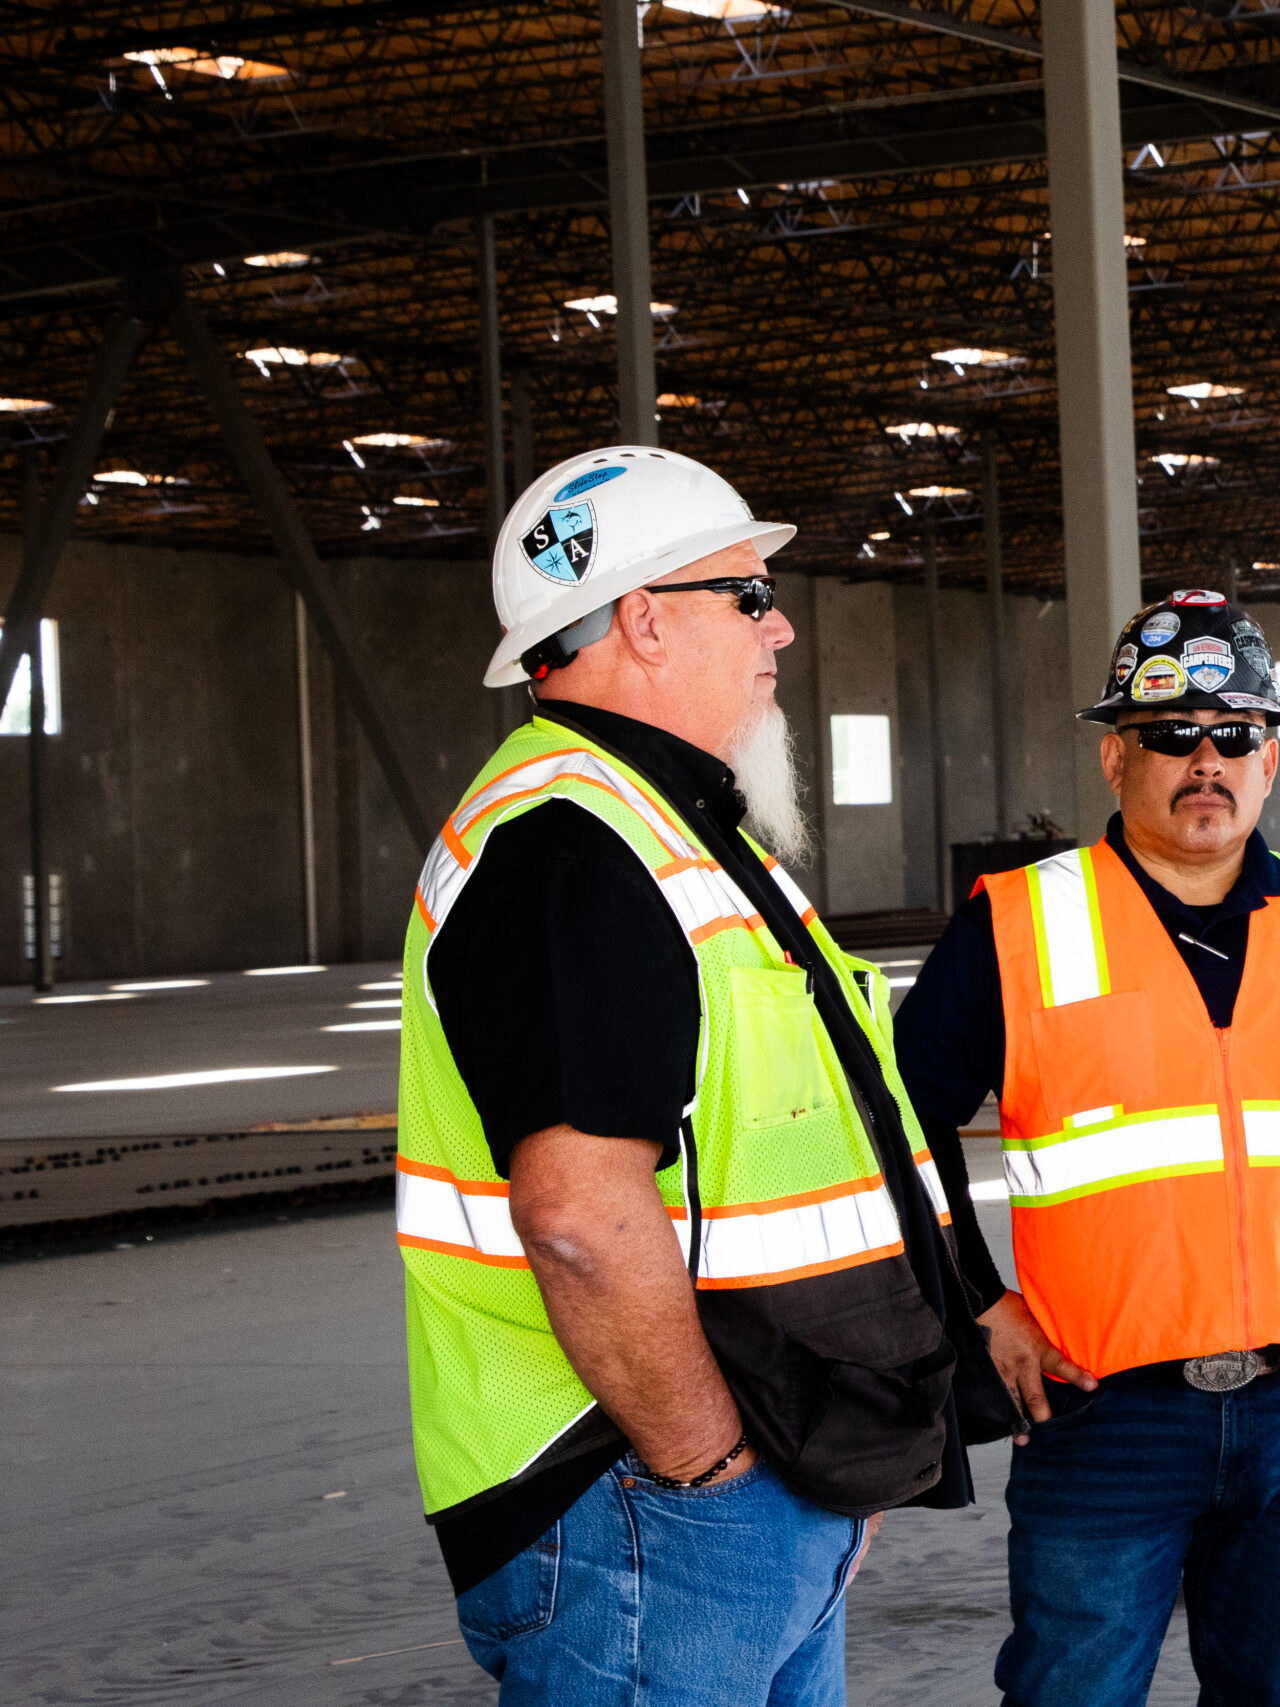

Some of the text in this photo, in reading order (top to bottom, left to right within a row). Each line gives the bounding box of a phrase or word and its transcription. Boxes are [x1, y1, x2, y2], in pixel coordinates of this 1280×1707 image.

[533, 525, 550, 550] S
[570, 538, 590, 563] A
[1183, 652, 1233, 670] CARPENTERS
